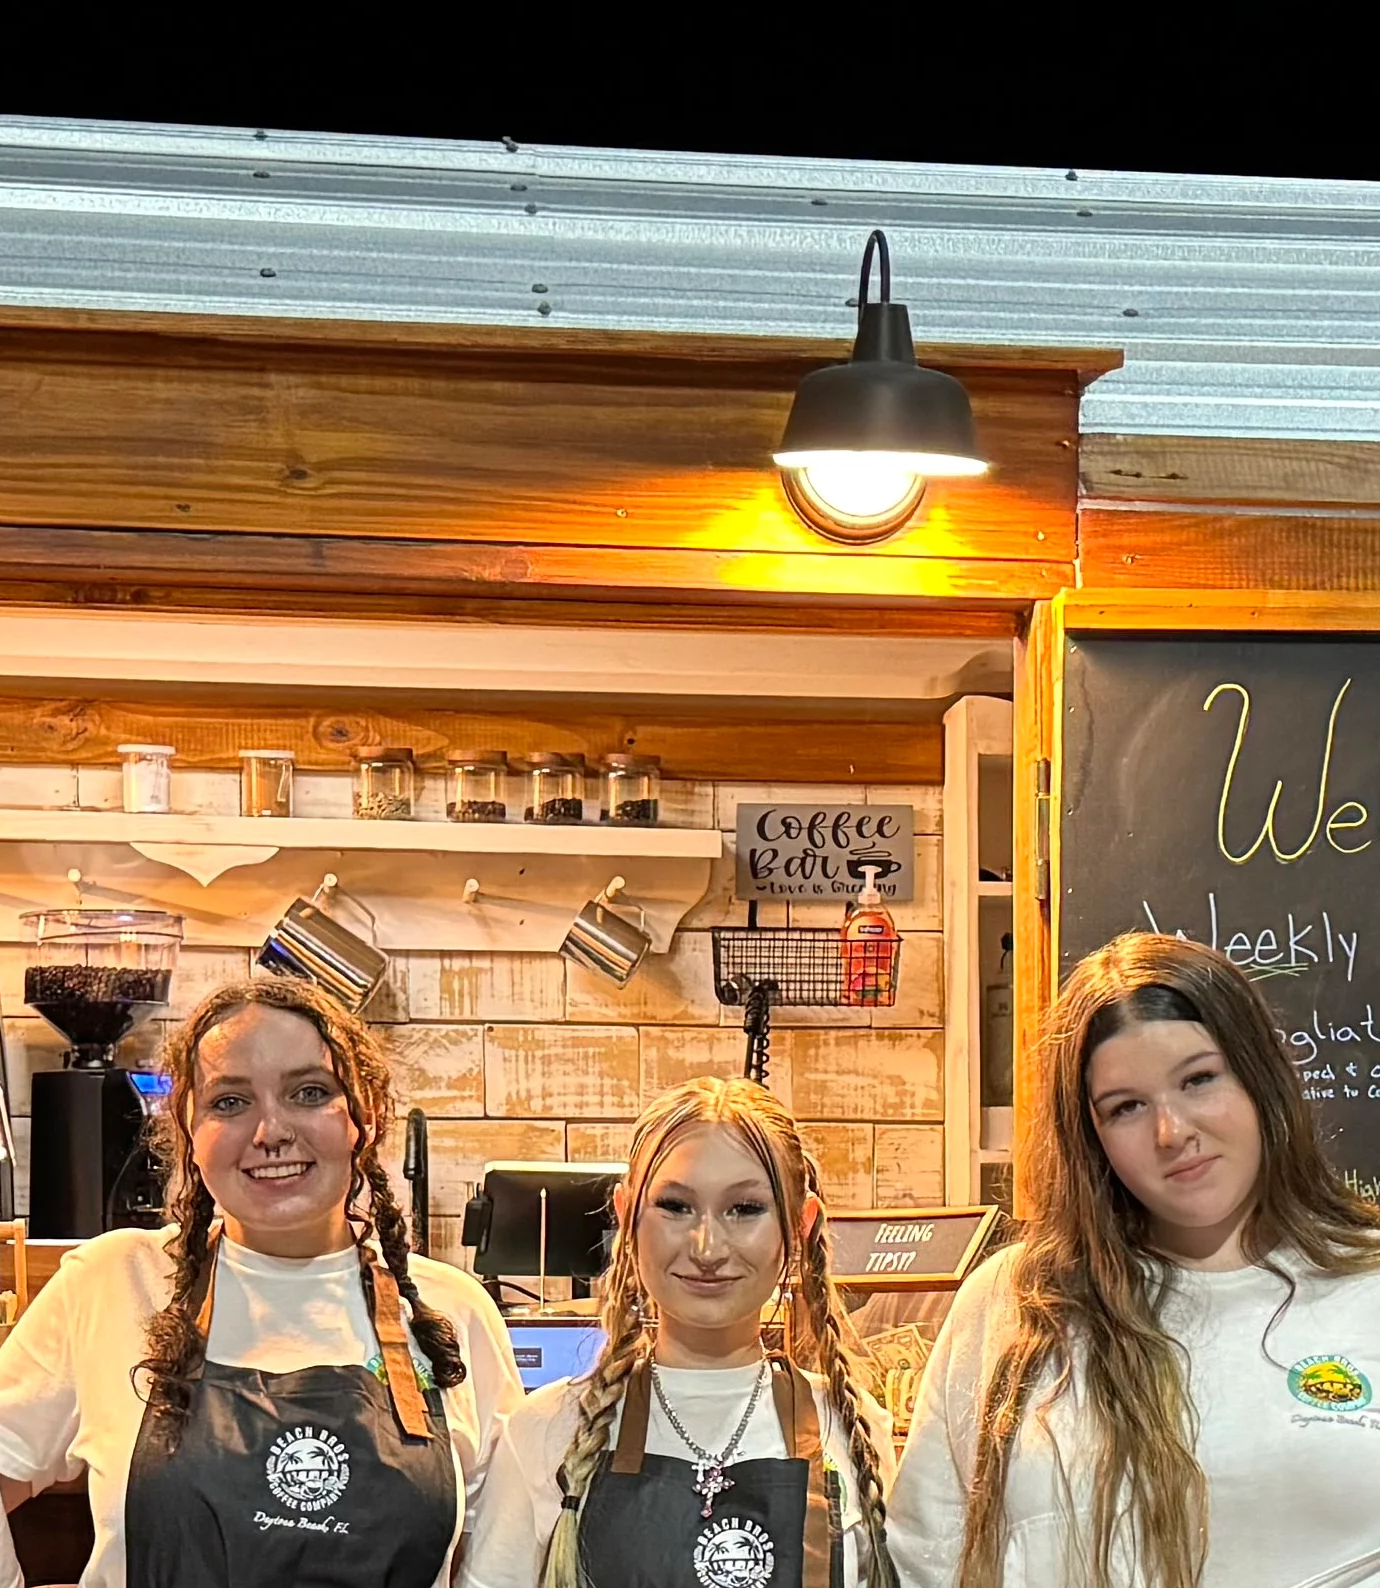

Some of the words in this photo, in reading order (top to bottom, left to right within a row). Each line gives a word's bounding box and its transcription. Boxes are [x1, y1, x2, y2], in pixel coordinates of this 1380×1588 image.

[756, 808, 901, 848] Coffee
[750, 848, 840, 880] Bar
[1343, 1083, 1359, 1099] to
[875, 1223, 935, 1243] FEELING
[269, 1426, 313, 1455] BEACH
[319, 1429, 349, 1461] BROS
[269, 1482, 298, 1509] COFFEE
[299, 1489, 342, 1511] COMPANY
[697, 1517, 739, 1546] BEACH
[744, 1519, 774, 1551] BROS
